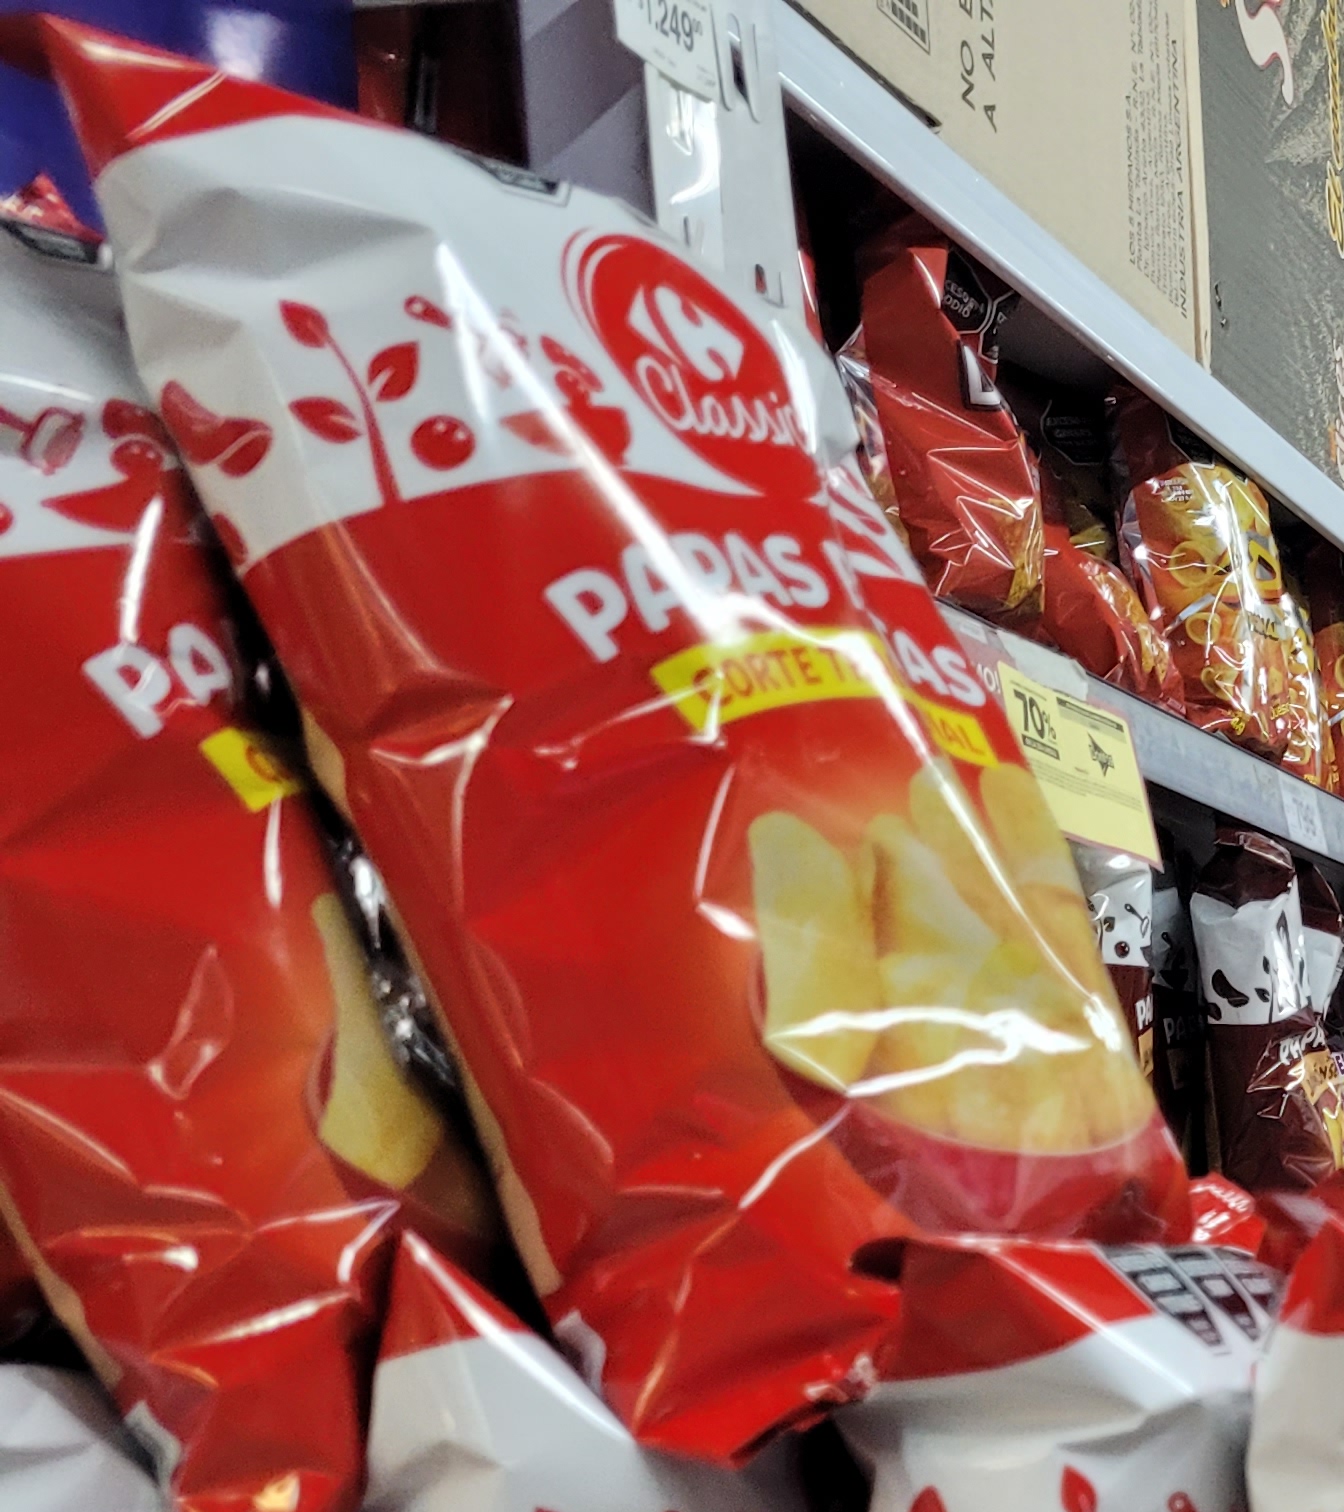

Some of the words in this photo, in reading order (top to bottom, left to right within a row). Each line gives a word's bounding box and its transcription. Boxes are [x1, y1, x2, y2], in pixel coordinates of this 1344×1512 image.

[960, 40, 975, 111] NO
[983, 104, 997, 133] A
[1171, 38, 1184, 182] ARGENTINA
[1177, 190, 1187, 318] INDUSTRIA
[546, 531, 829, 664] PAPAS
[1013, 688, 1058, 740] 70%
